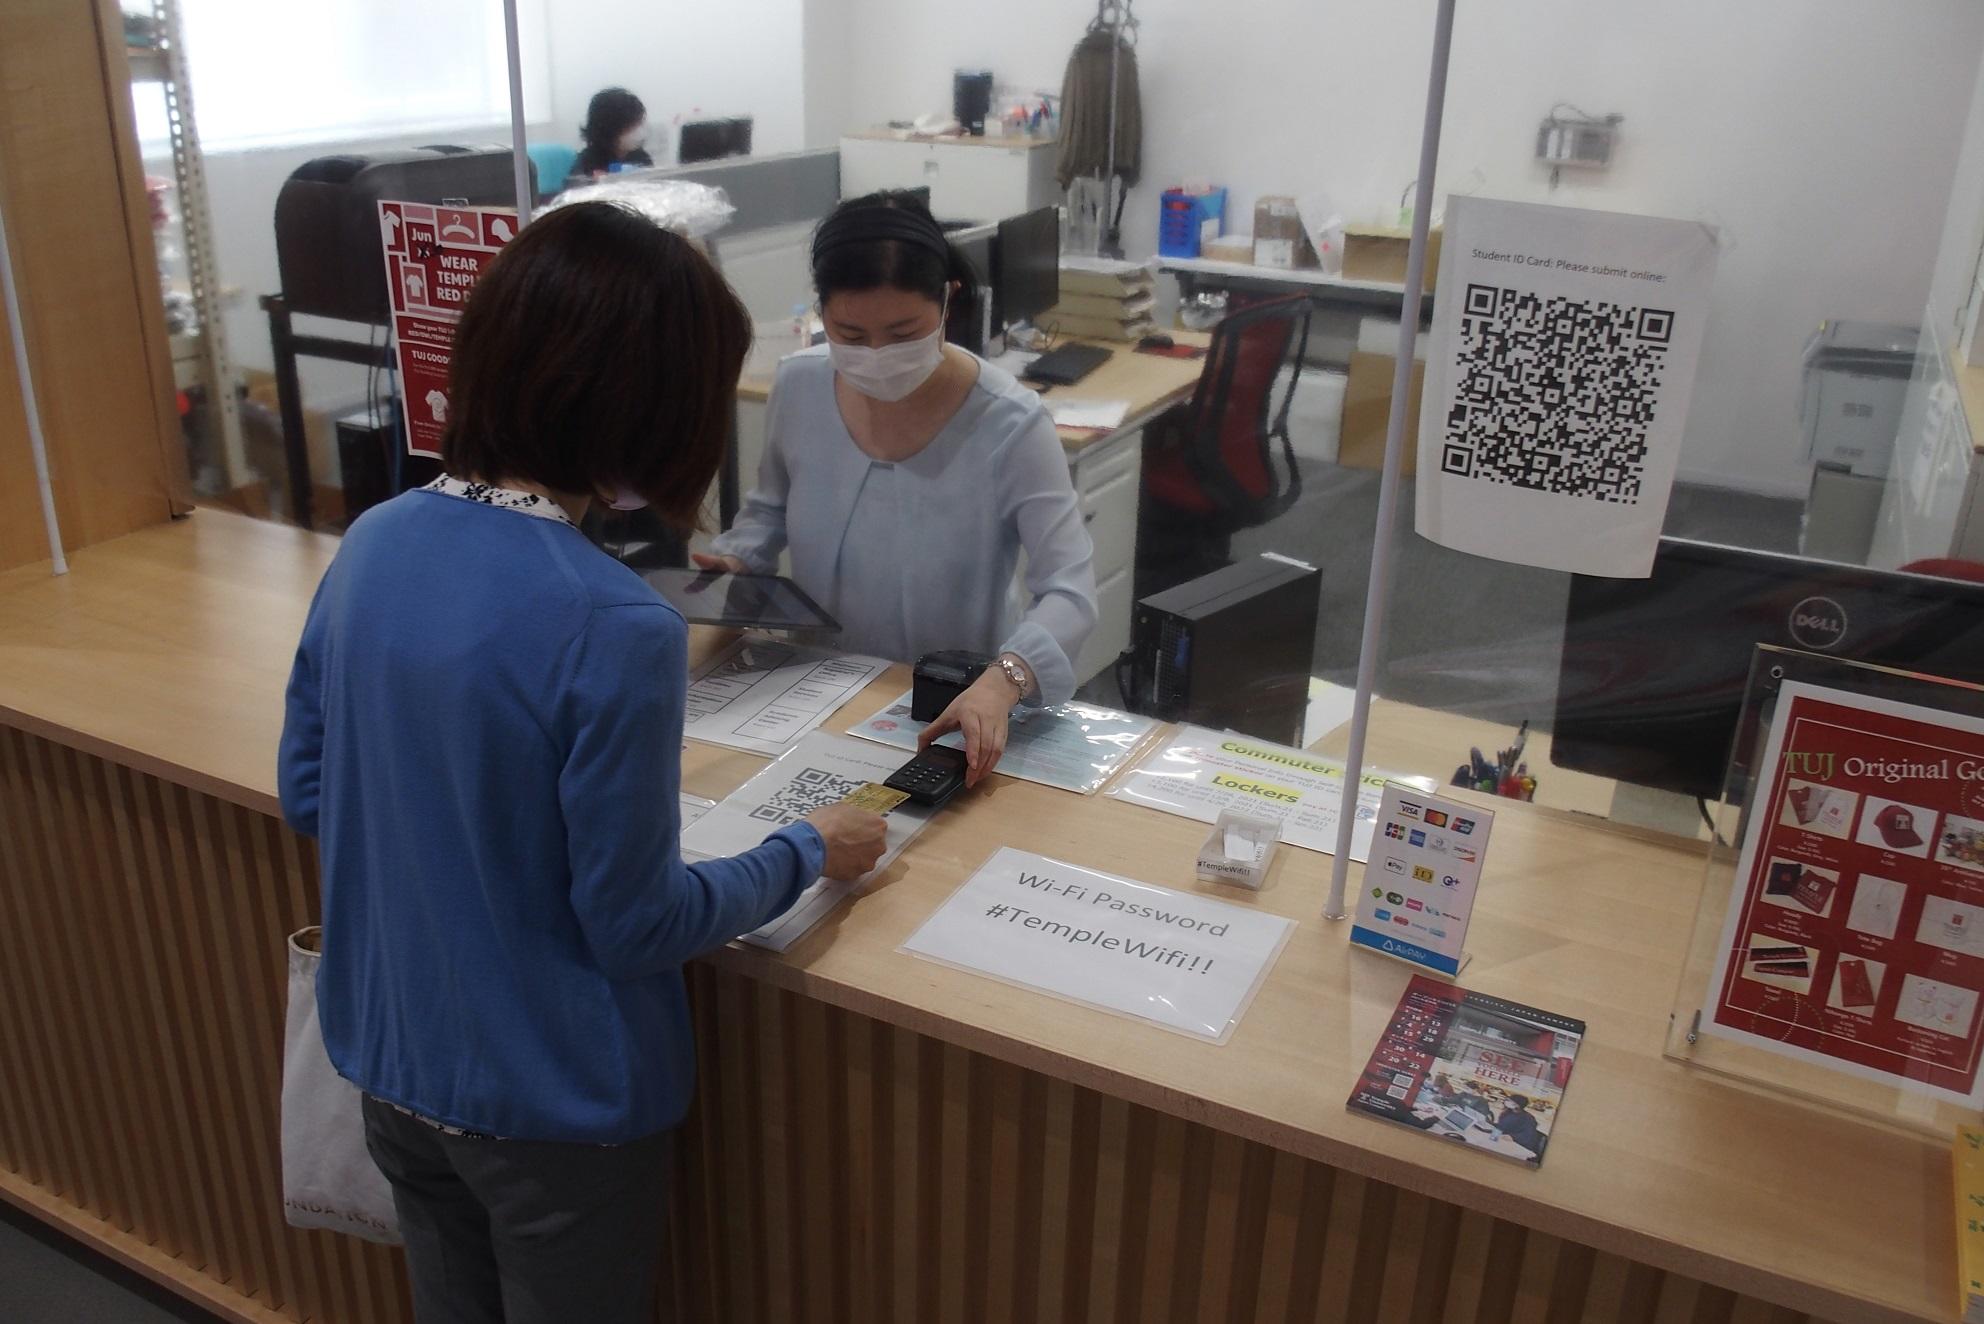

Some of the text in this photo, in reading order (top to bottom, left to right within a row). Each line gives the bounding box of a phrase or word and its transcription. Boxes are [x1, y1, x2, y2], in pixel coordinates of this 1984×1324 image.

[412, 228, 432, 243] Jun
[440, 255, 478, 272] WEAR
[1471, 249, 1511, 263] Student
[1514, 255, 1524, 264] ID
[1526, 256, 1553, 268] Card:
[1555, 259, 1589, 273] Please
[1591, 265, 1628, 278] submit
[437, 287, 461, 302] RED
[412, 350, 426, 361] TUJ
[1796, 614, 1840, 632] DELL
[1221, 742, 1335, 775] Commuter
[1783, 752, 1835, 781] TUJ
[1843, 757, 1949, 783] Original
[1212, 776, 1299, 804] Lockers
[1402, 805, 1418, 815] VISA
[1197, 860, 1250, 876] #TempleWifi!!
[1018, 871, 1229, 937] Wi-Fi Password
[986, 903, 1213, 975] #TempleWifi!!
[1474, 1066, 1520, 1087] HERE
